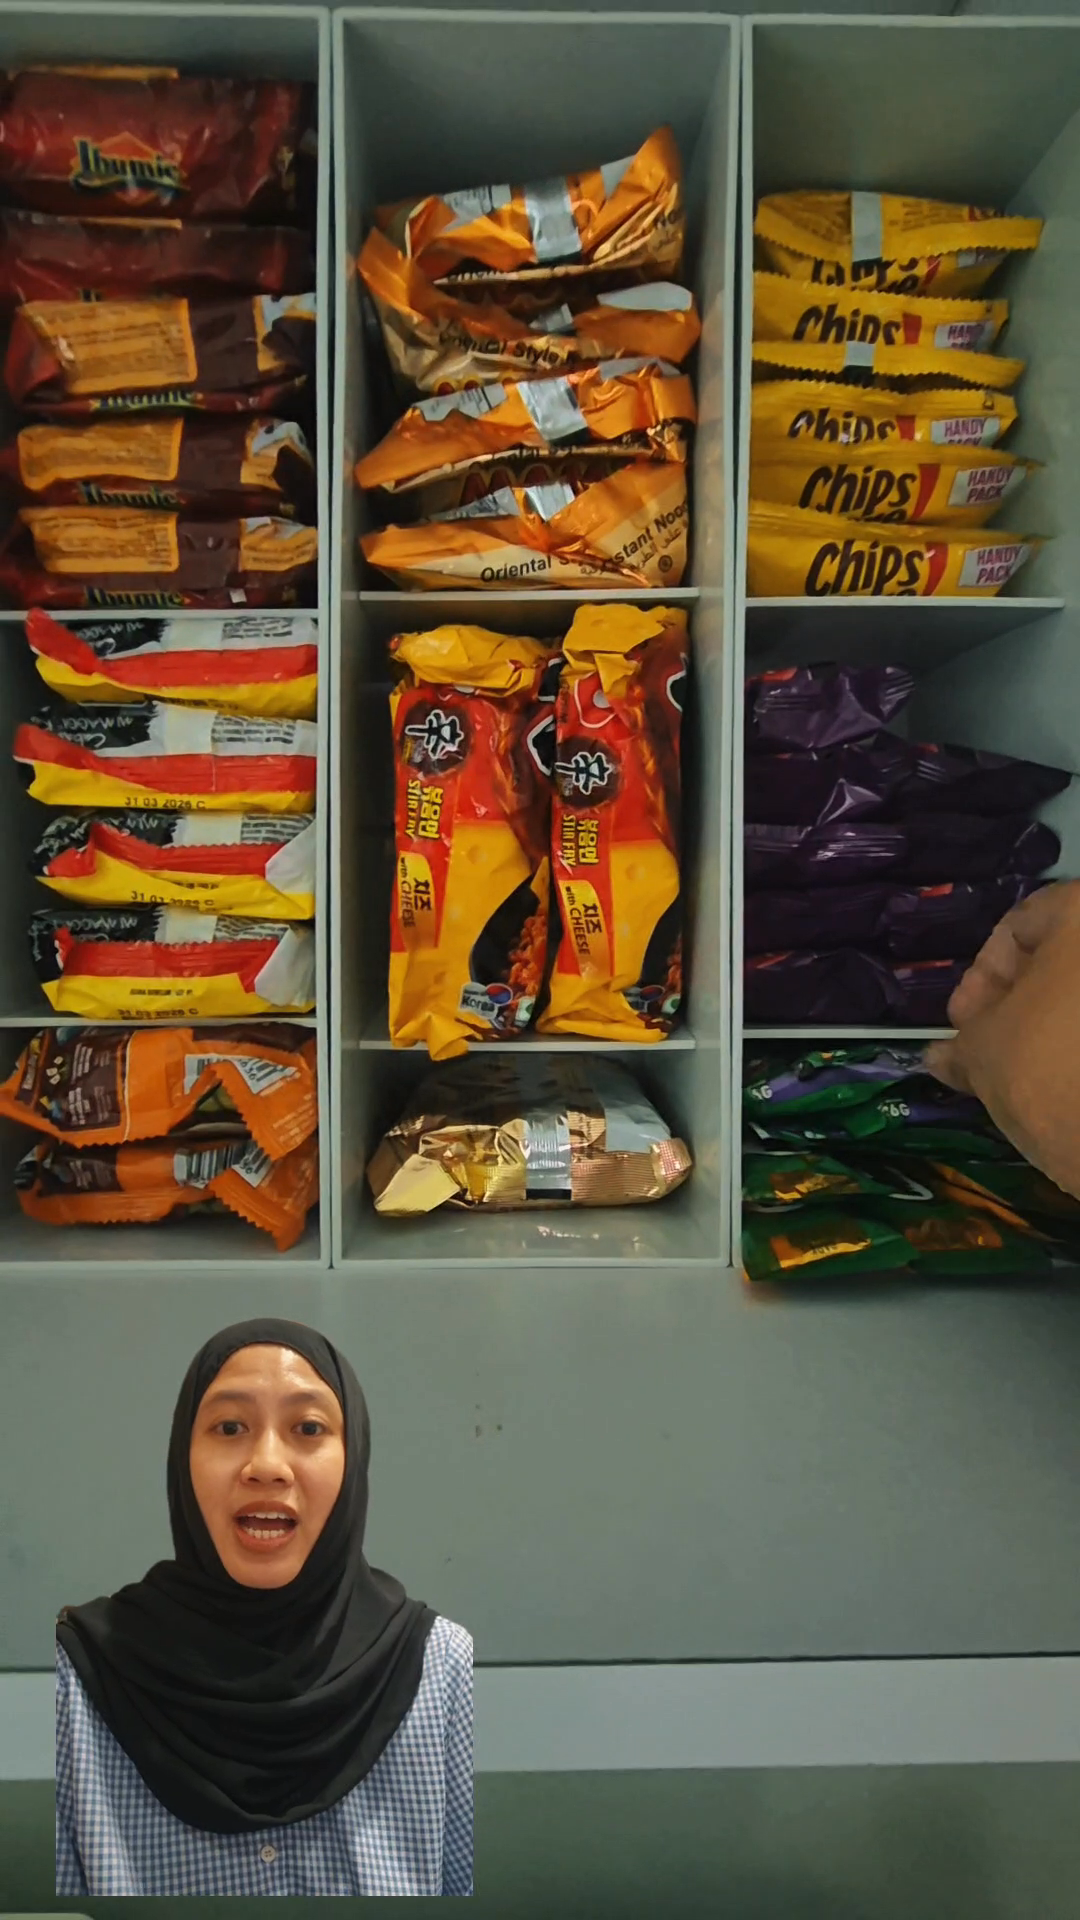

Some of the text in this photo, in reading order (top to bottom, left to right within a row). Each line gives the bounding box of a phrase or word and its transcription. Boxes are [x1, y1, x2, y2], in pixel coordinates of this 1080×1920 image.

[798, 462, 917, 518] Chips
[967, 467, 1014, 487] HANDY
[965, 485, 1005, 503] PACK
[480, 555, 552, 583] Oriental
[804, 538, 925, 596] Chips
[976, 545, 1023, 566] HANDY
[562, 813, 577, 840] STIR
[576, 818, 600, 864] 볶음면
[561, 841, 577, 867] FRY
[400, 880, 416, 929] CHEESE
[413, 877, 432, 911] 치즈
[565, 885, 591, 956] with CHEESE
[582, 902, 603, 934] 치즈
